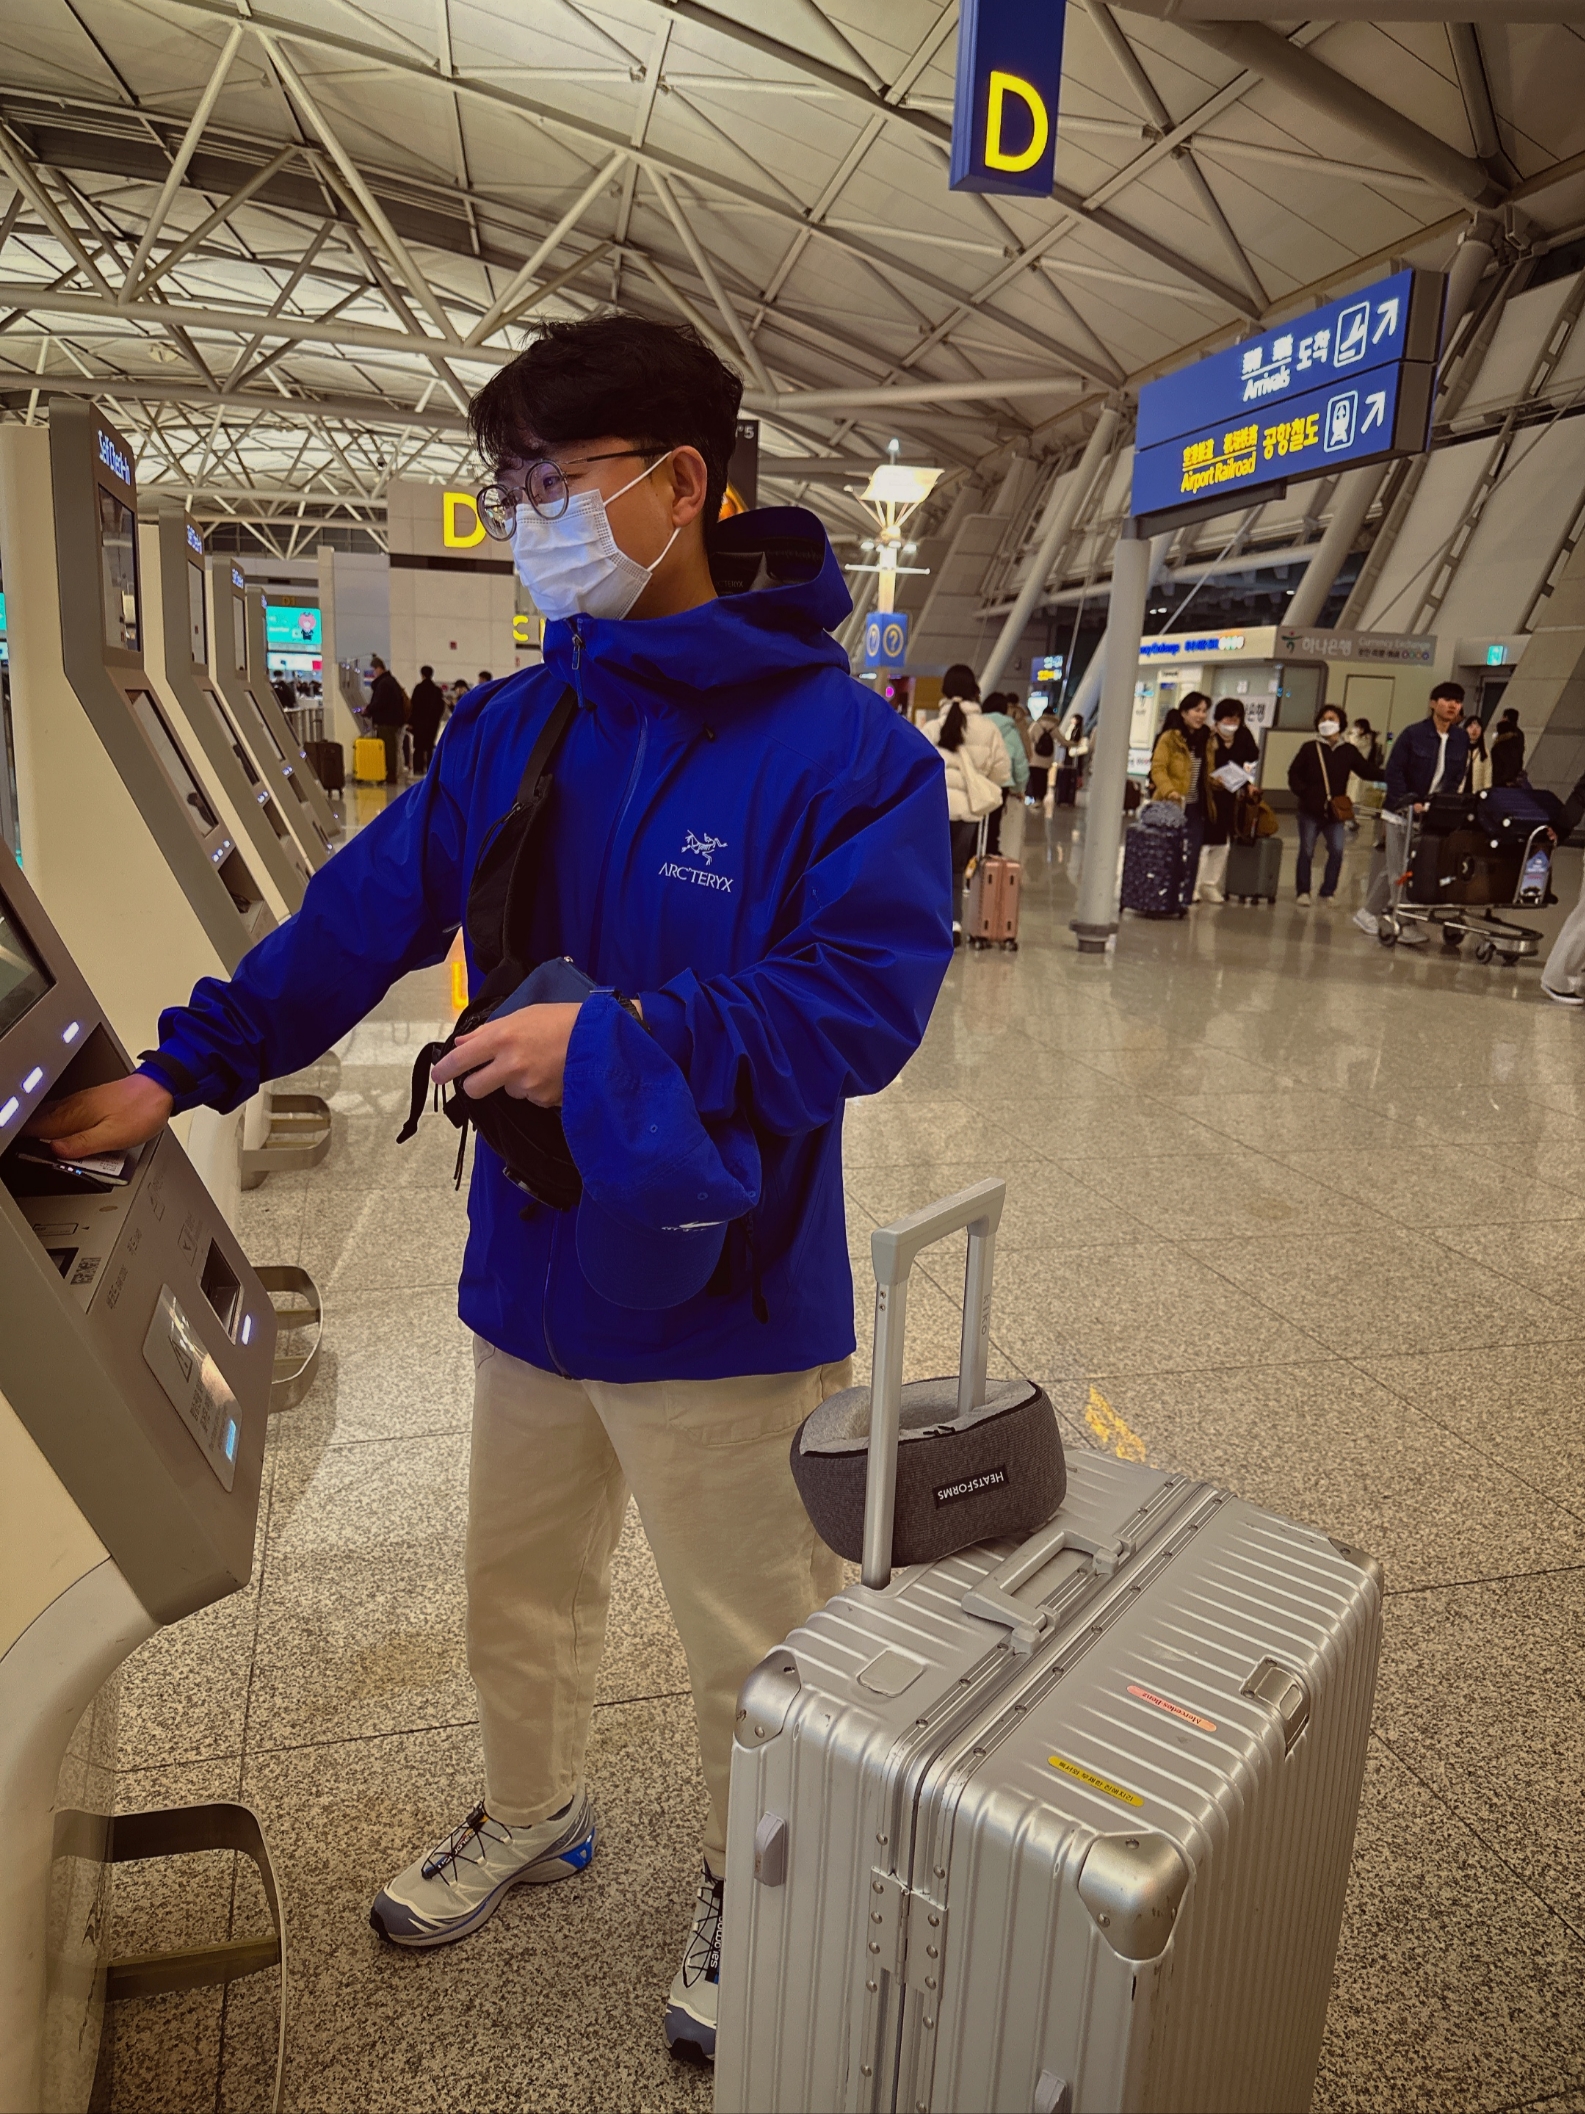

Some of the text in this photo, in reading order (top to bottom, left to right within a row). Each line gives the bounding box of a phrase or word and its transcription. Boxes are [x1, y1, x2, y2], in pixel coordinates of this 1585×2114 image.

[985, 70, 1049, 173] D
[1296, 328, 1331, 371] 도착
[1262, 413, 1320, 460] 공항철도
[1181, 466, 1214, 494] Airport
[1215, 451, 1257, 483] Railroad
[443, 491, 487, 549] D
[1302, 637, 1352, 657] 하나은행
[937, 1471, 1005, 1500] HEATSFORMS
